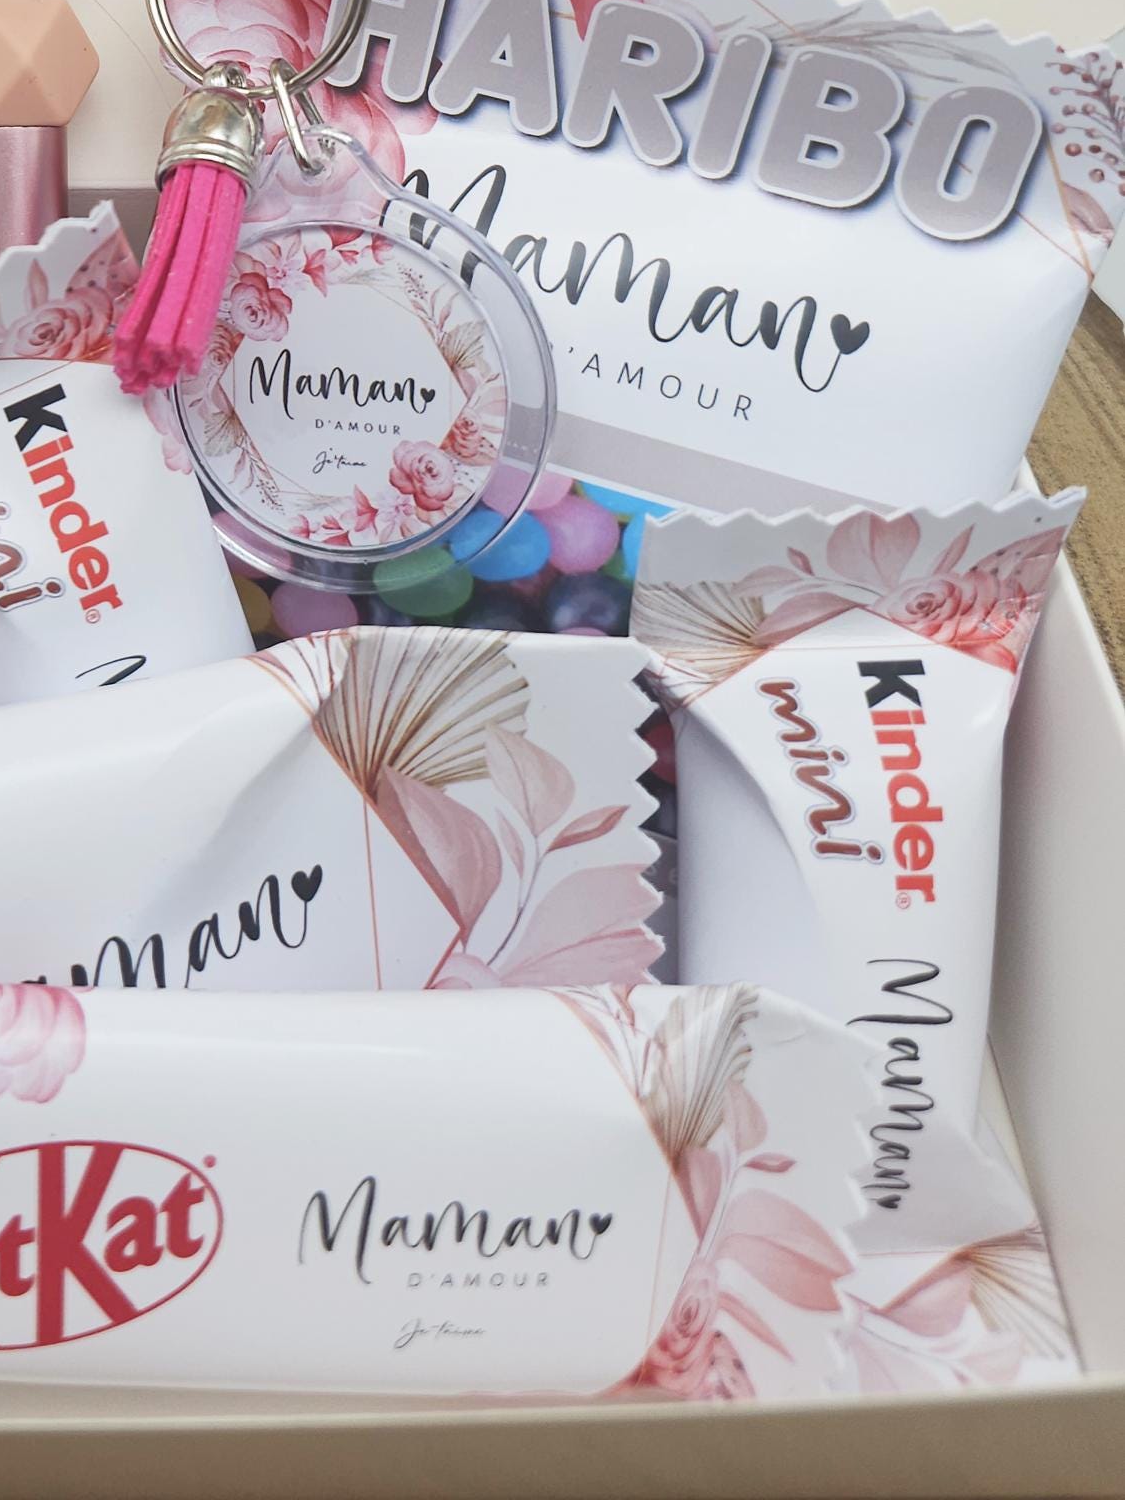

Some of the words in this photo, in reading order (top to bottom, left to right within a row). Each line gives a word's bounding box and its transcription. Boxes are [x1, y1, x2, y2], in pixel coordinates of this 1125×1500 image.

[380, 164, 847, 394] Maman
[249, 349, 427, 419] Maman
[315, 418, 402, 436] D'AMOUR
[565, 344, 753, 421] 'AMOUR
[3, 383, 123, 613] Kinder
[757, 678, 883, 865] mini
[857, 659, 944, 905] Kinder
[846, 958, 953, 1200] Maman
[298, 1175, 598, 1284] Maman
[407, 1271, 550, 1288] D'AMOUR
